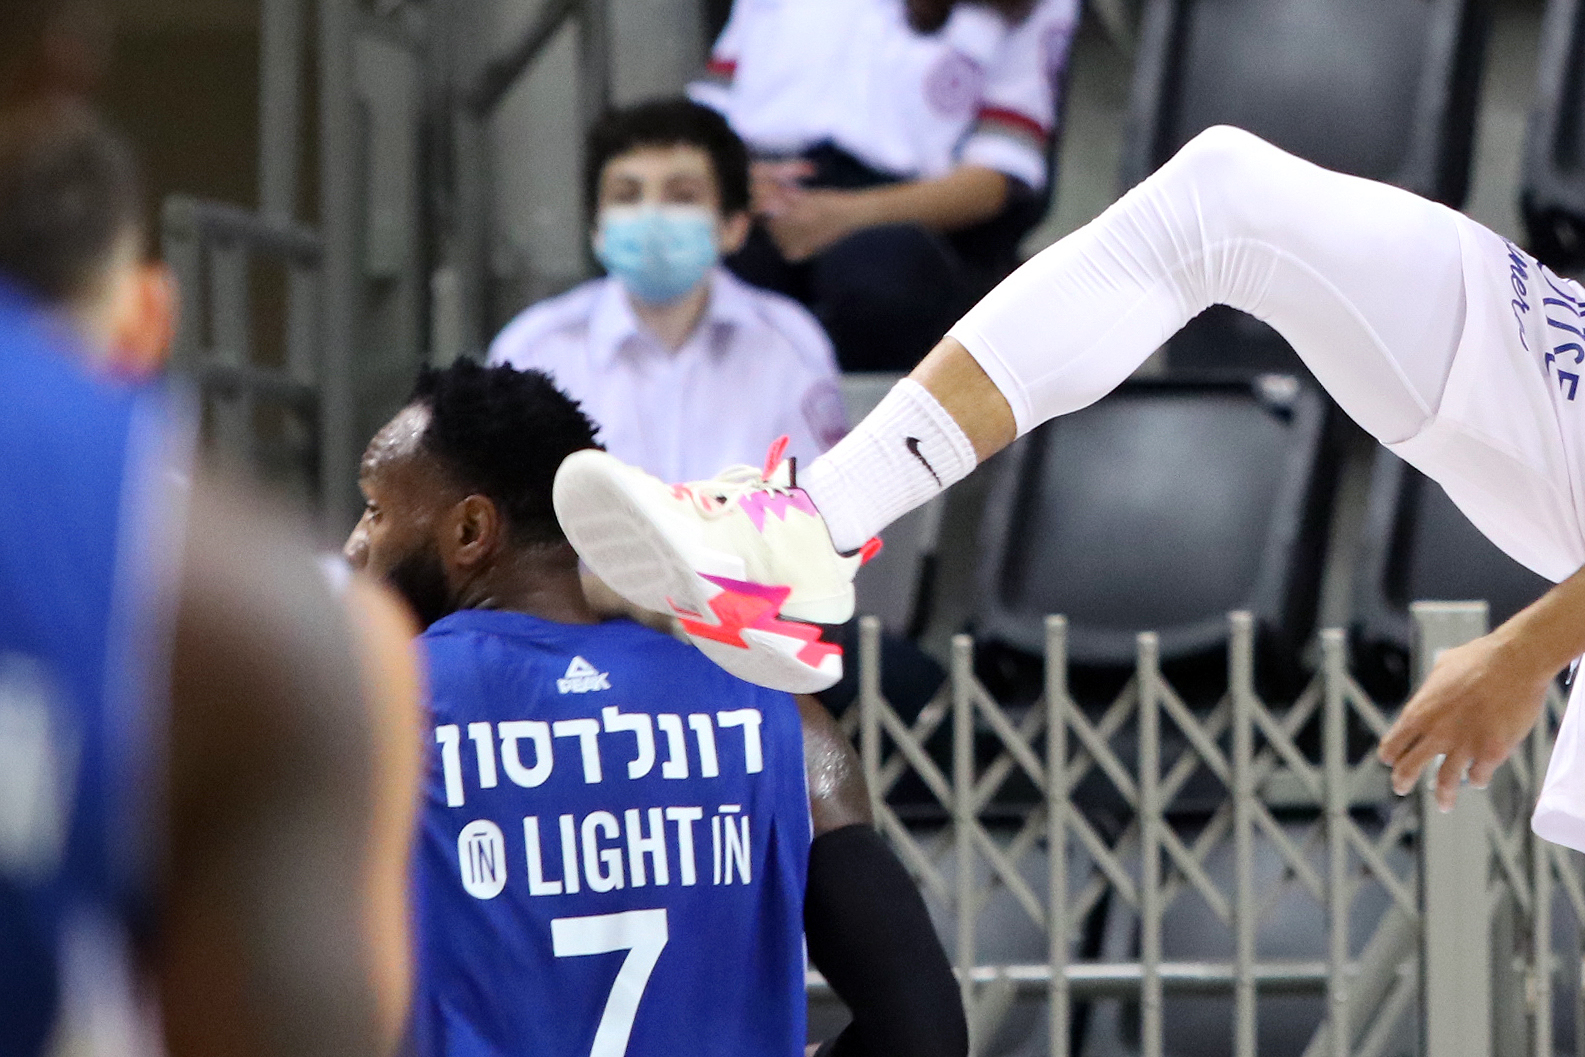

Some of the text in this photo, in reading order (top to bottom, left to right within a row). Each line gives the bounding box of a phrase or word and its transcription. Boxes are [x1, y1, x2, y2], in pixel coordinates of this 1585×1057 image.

[436, 706, 763, 807] דונלדסון
[523, 806, 702, 896] LIGHT
[551, 908, 668, 1057] 7
